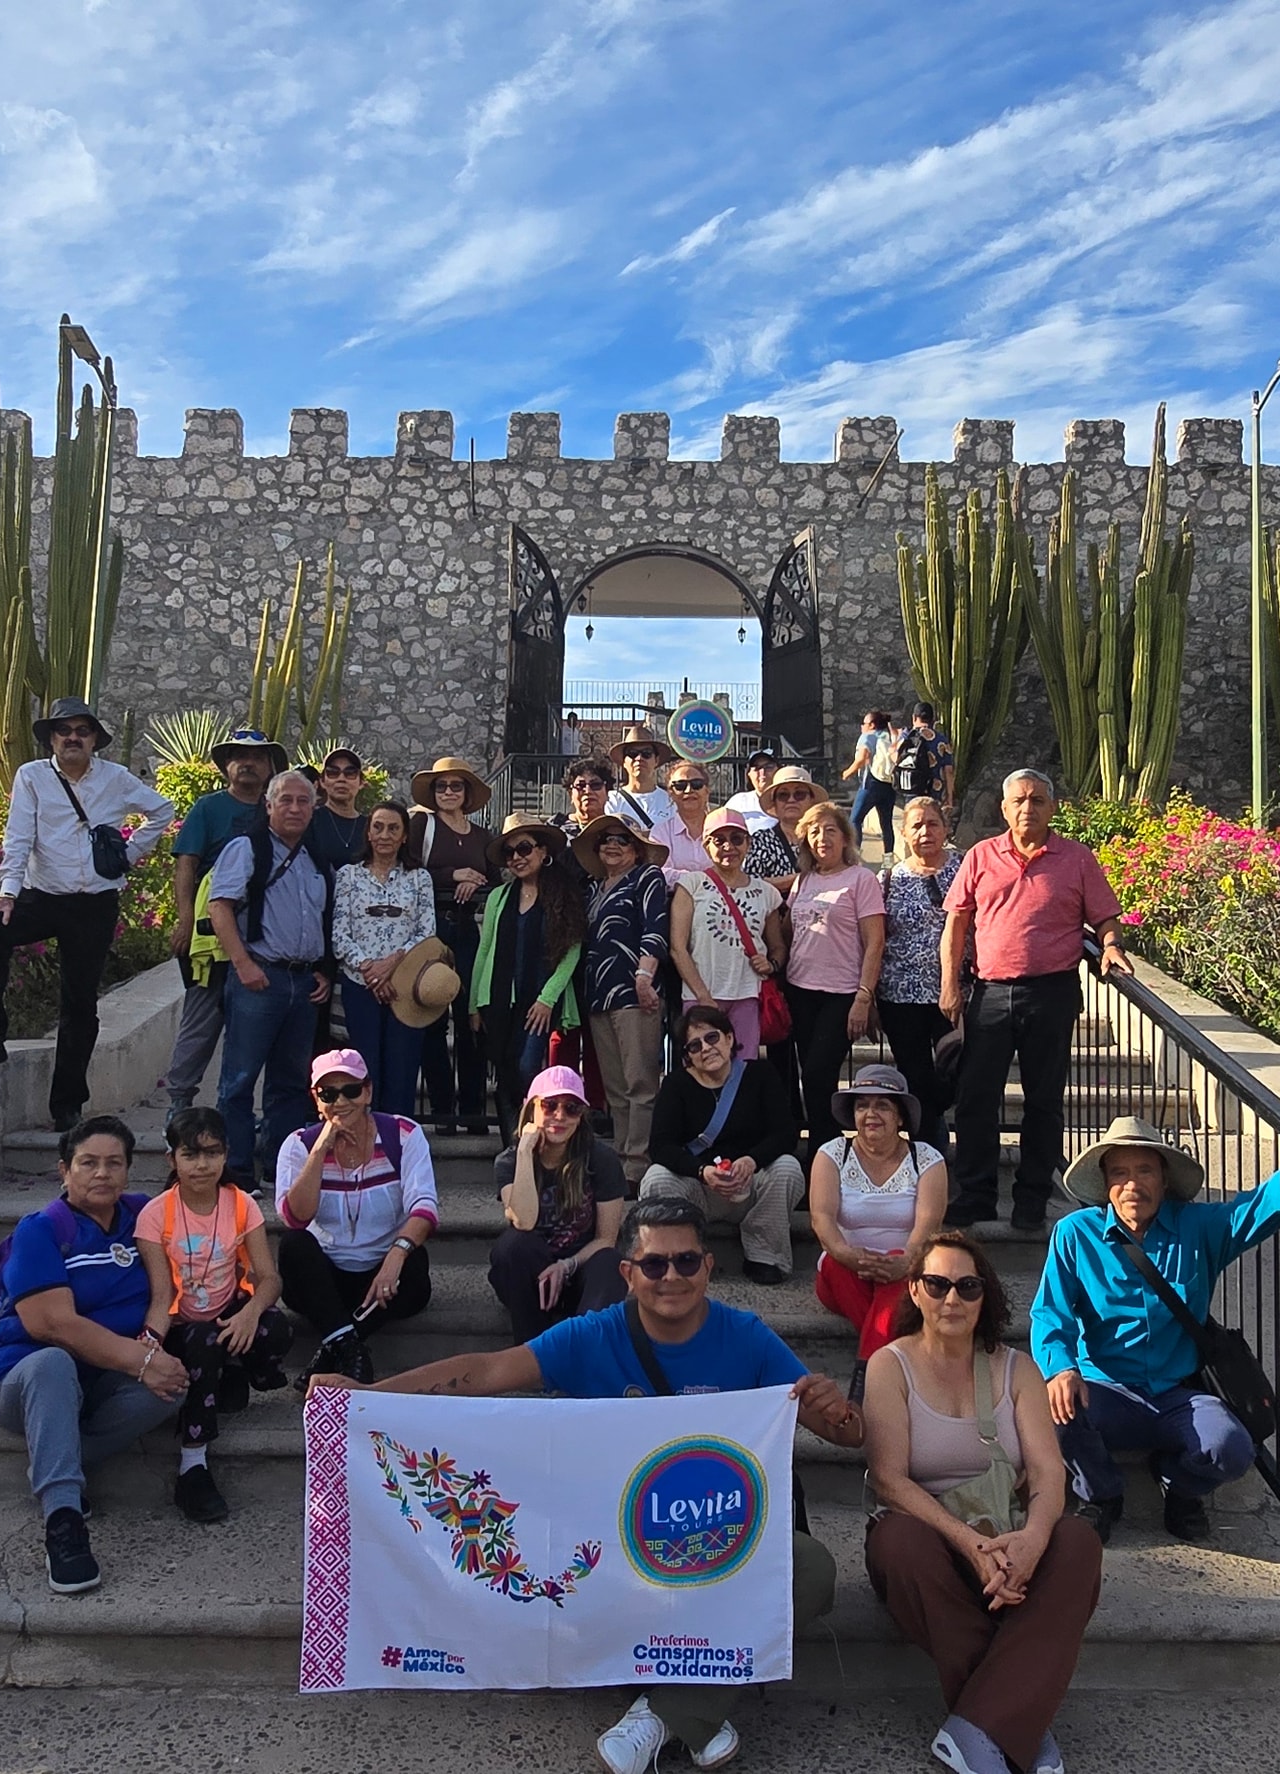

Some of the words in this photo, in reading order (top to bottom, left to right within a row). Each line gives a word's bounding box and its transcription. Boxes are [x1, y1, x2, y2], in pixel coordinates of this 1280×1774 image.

[682, 718, 722, 735] Levita
[651, 1489, 741, 1523] Levita
[670, 1514, 723, 1532] TOURS
[650, 1635, 709, 1647] Preferimos
[447, 1654, 465, 1663] por
[633, 1644, 735, 1661] Cansarnos
[403, 1657, 465, 1674] México
[635, 1664, 653, 1675] que
[655, 1660, 754, 1678] Oxidarnos
